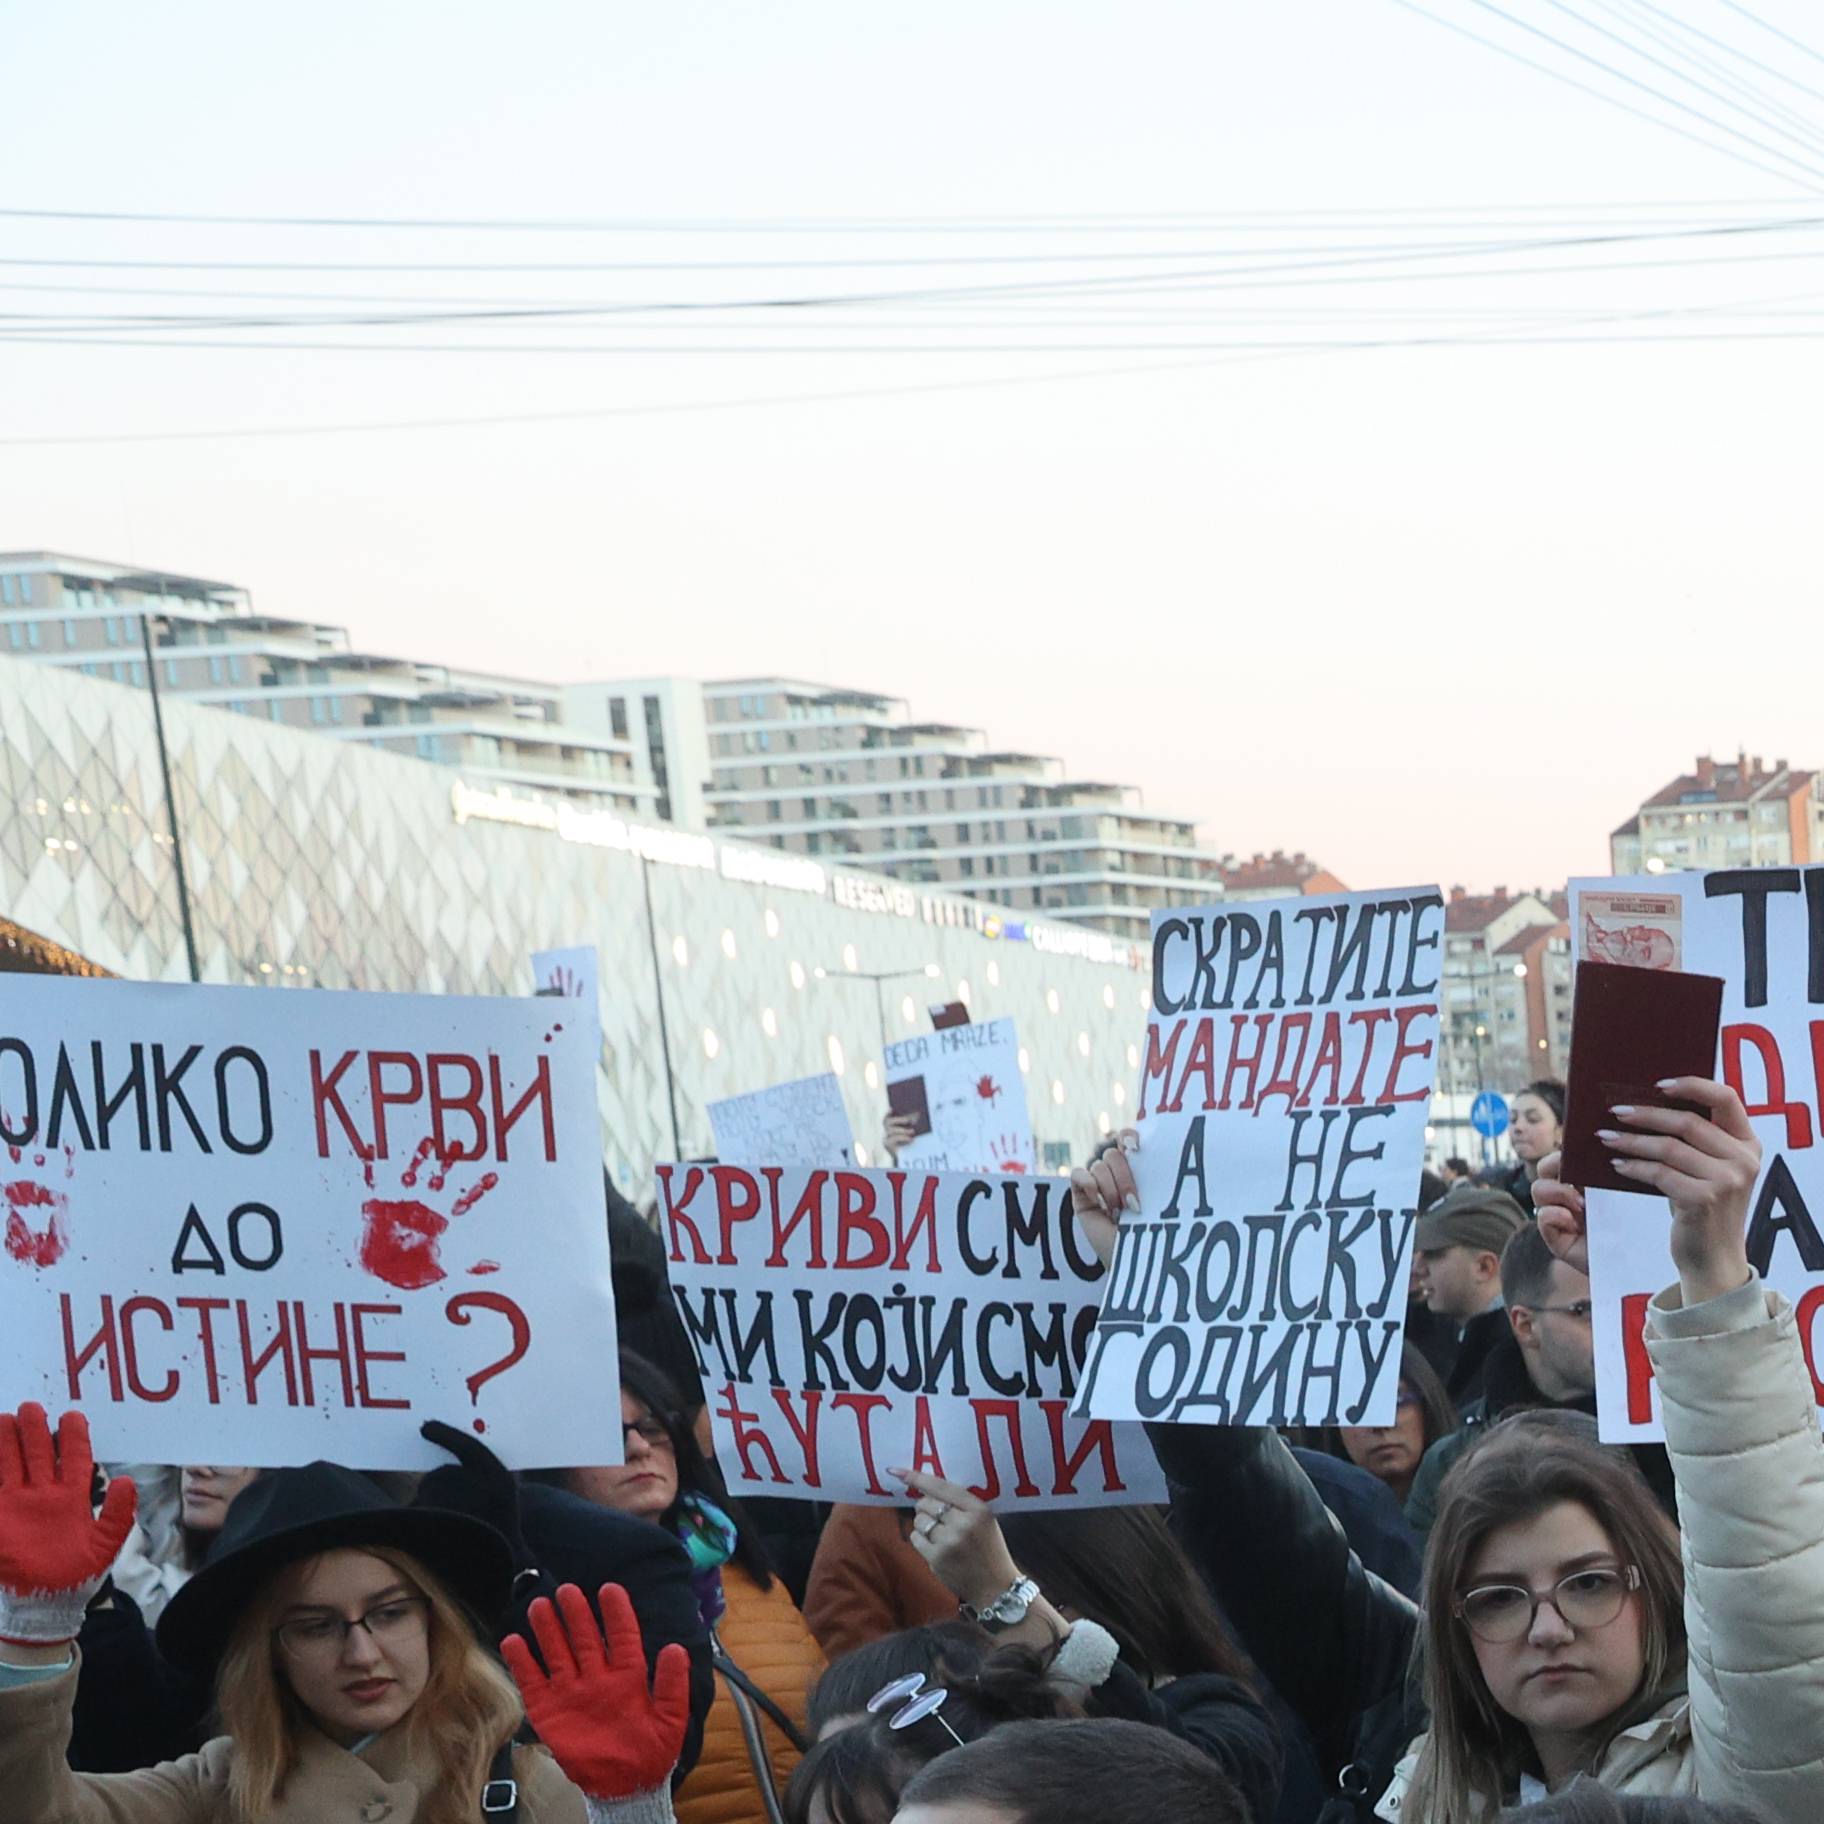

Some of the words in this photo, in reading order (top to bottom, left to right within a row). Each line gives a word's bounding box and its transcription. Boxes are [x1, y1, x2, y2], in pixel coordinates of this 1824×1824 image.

[1152, 894, 1444, 1017] СКРАТИТЕ
[310, 1049, 557, 1162] КРВИ
[1137, 1003, 1438, 1121] МАНДАТЕ
[1168, 1115, 1206, 1219] А
[1272, 1104, 1395, 1213] НЕ
[171, 1201, 284, 1276] ДО
[656, 1164, 941, 1273] КРИВИ
[957, 1179, 1106, 1283] СМО
[1099, 1207, 1417, 1328] ШКОЛСКУ
[673, 1284, 777, 1386] МИ
[793, 1282, 970, 1397] КОЈИ
[1069, 1318, 1402, 1427] ГОДИНУ
[715, 1381, 1127, 1499] ЋУТАЛИ
